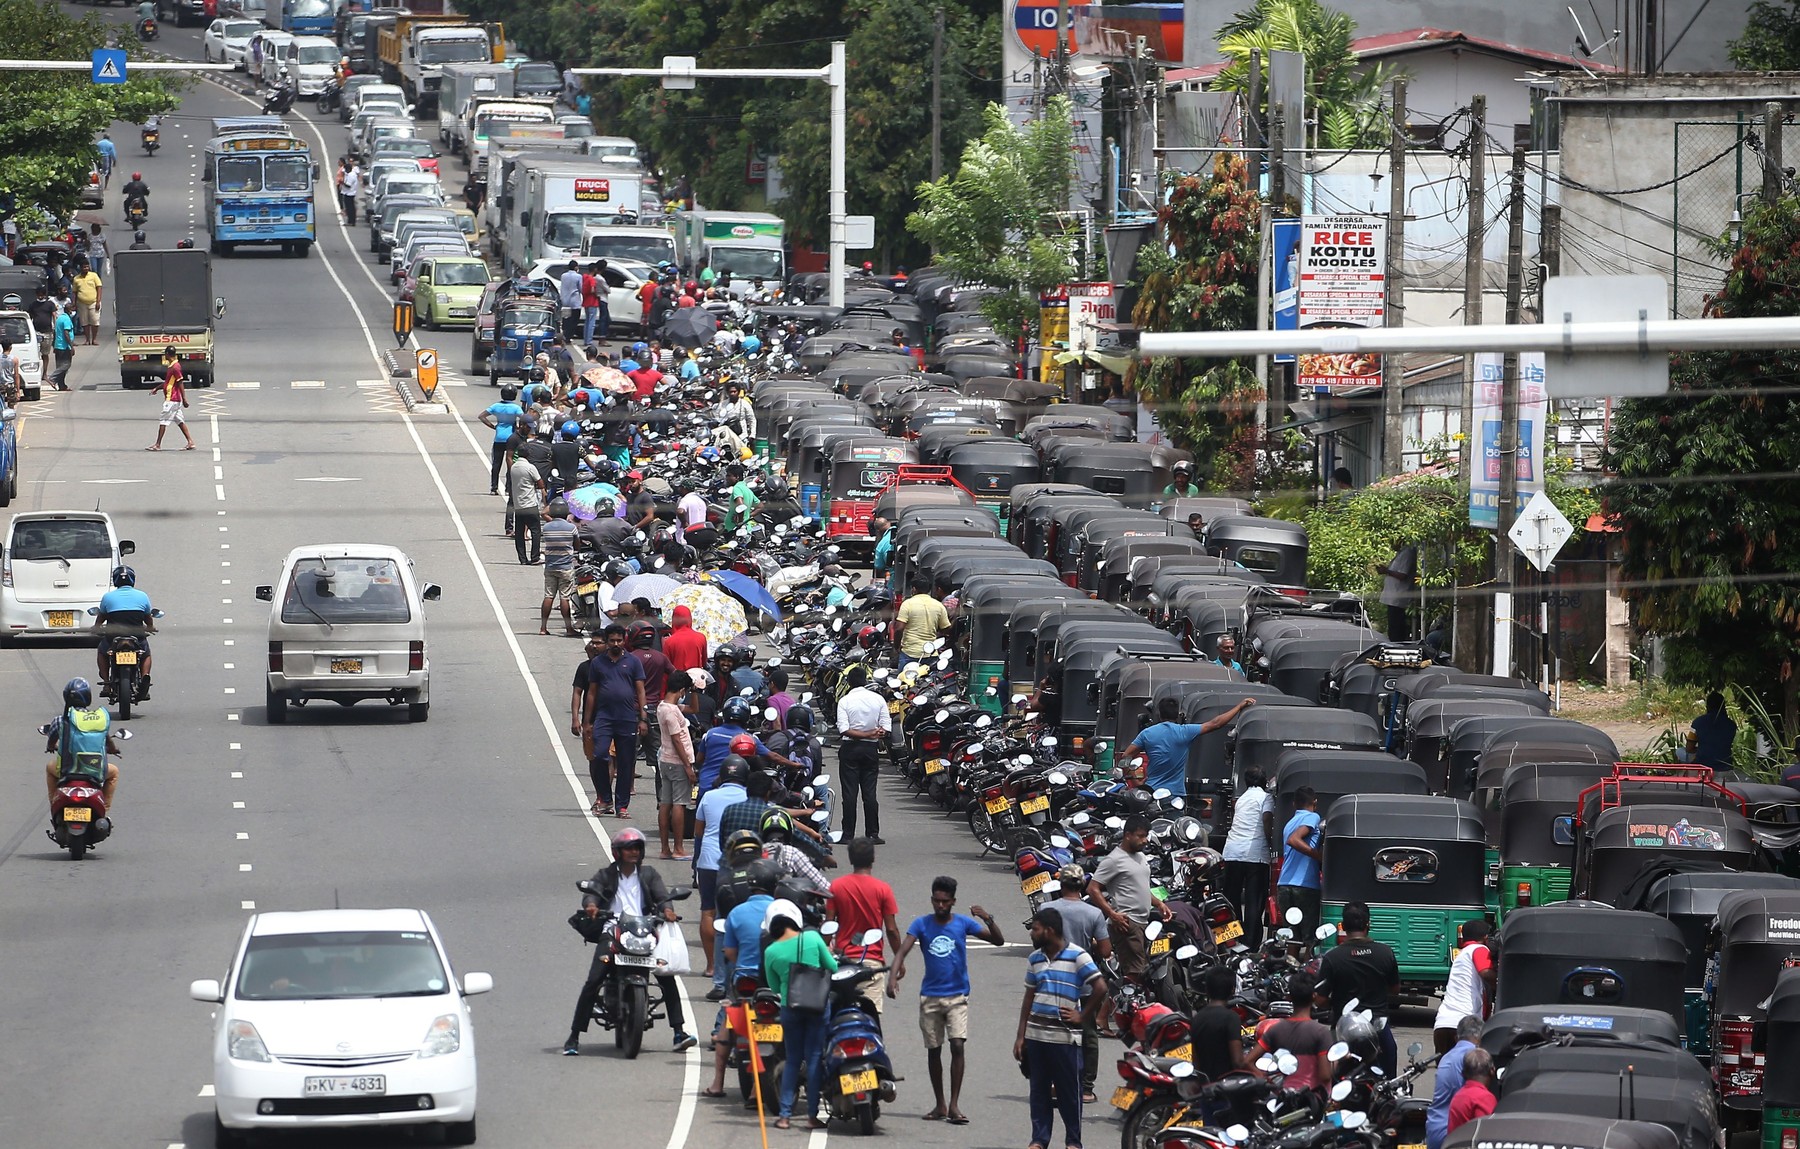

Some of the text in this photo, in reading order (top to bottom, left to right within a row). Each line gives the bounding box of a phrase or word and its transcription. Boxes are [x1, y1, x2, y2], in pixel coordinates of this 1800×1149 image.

[577, 181, 607, 189] TRUCK
[576, 192, 608, 200] MOVERS
[1314, 231, 1373, 246] RICE
[1310, 246, 1375, 257] KOTTU
[1308, 258, 1377, 267] NOODLES
[1065, 285, 1109, 297] Services
[139, 335, 190, 344] NISSAN
[1629, 824, 1669, 838] POWER OF
[1633, 837, 1664, 847] WORLD
[1769, 917, 1800, 930] Freedo
[318, 1079, 337, 1092] KV
[351, 1077, 383, 1091] 4831
